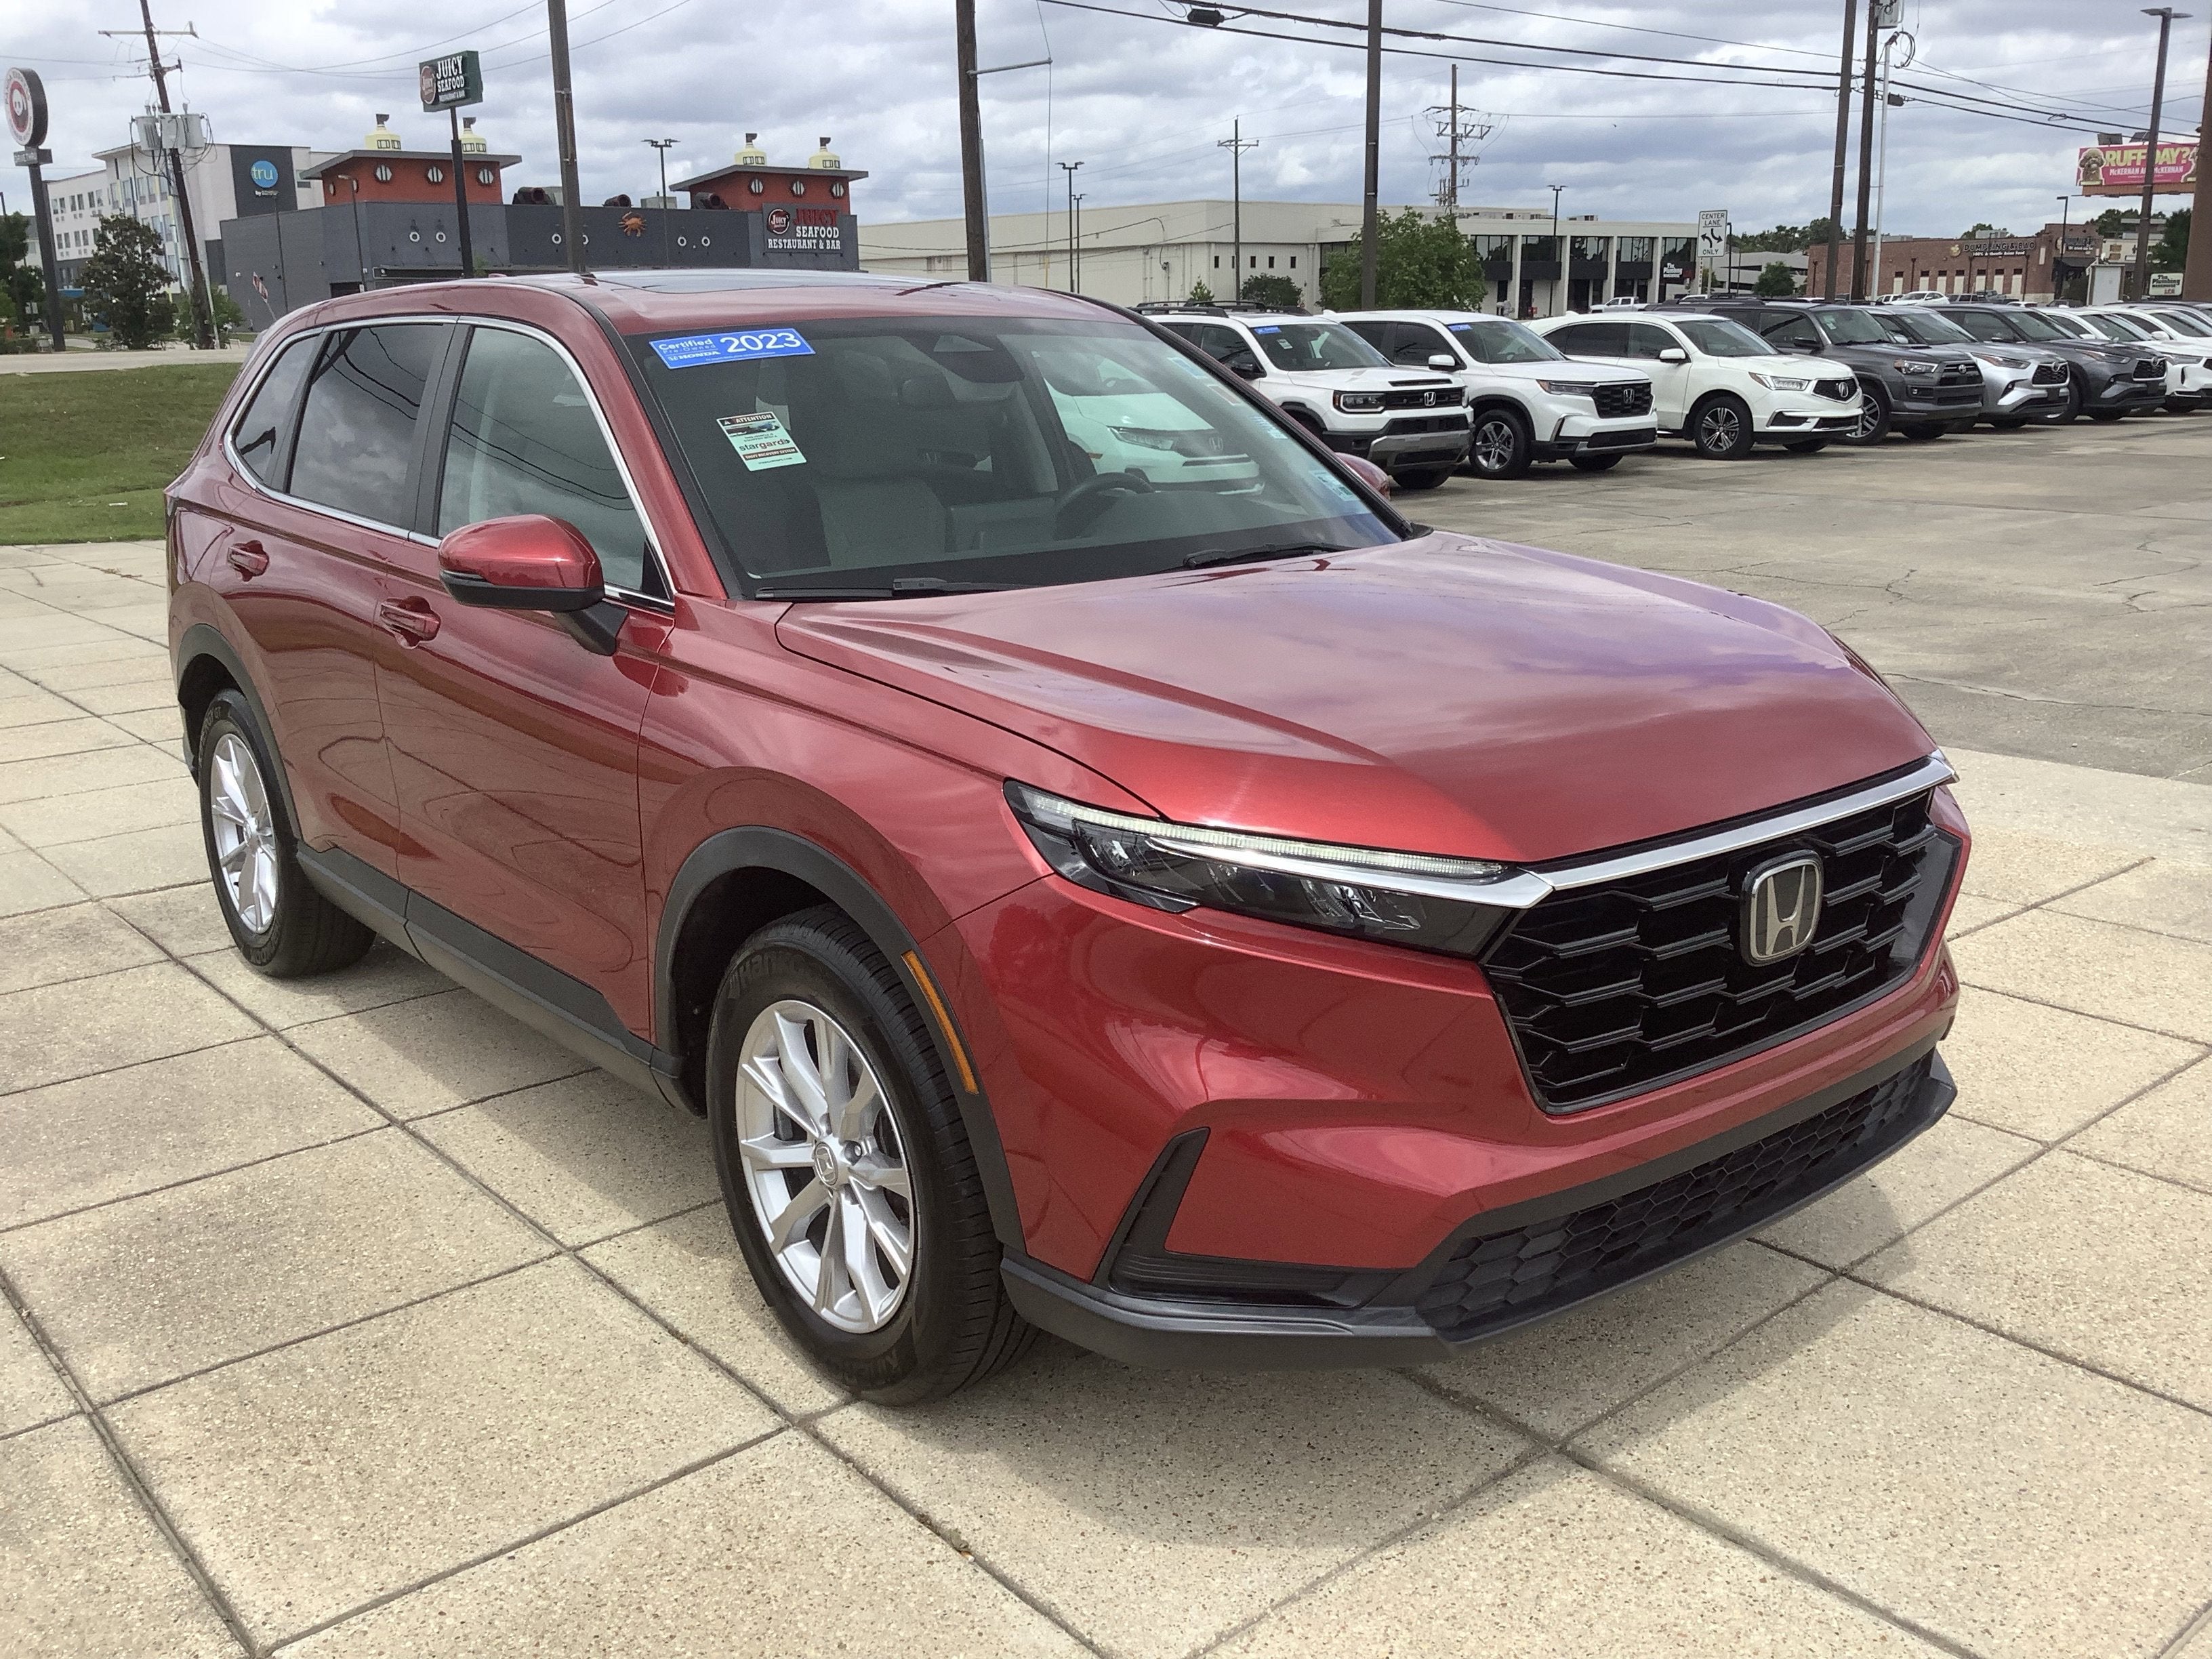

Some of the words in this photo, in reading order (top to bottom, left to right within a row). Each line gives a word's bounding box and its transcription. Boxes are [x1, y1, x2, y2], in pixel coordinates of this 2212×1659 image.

[436, 56, 462, 79] JUICY
[437, 75, 465, 92] SEAFOOD
[2105, 150, 2148, 167] RUFF
[252, 167, 274, 180] tru
[793, 208, 837, 226] JUICY
[796, 226, 840, 238] SEAFOOD
[768, 239, 817, 249] RESTAURANT
[819, 239, 825, 249] &
[826, 240, 840, 249] BAR
[658, 338, 713, 350] Certified
[720, 332, 801, 353] 2023
[678, 350, 721, 359] HONDA
[736, 413, 773, 424] ATTENTION
[739, 438, 785, 451] stargard
